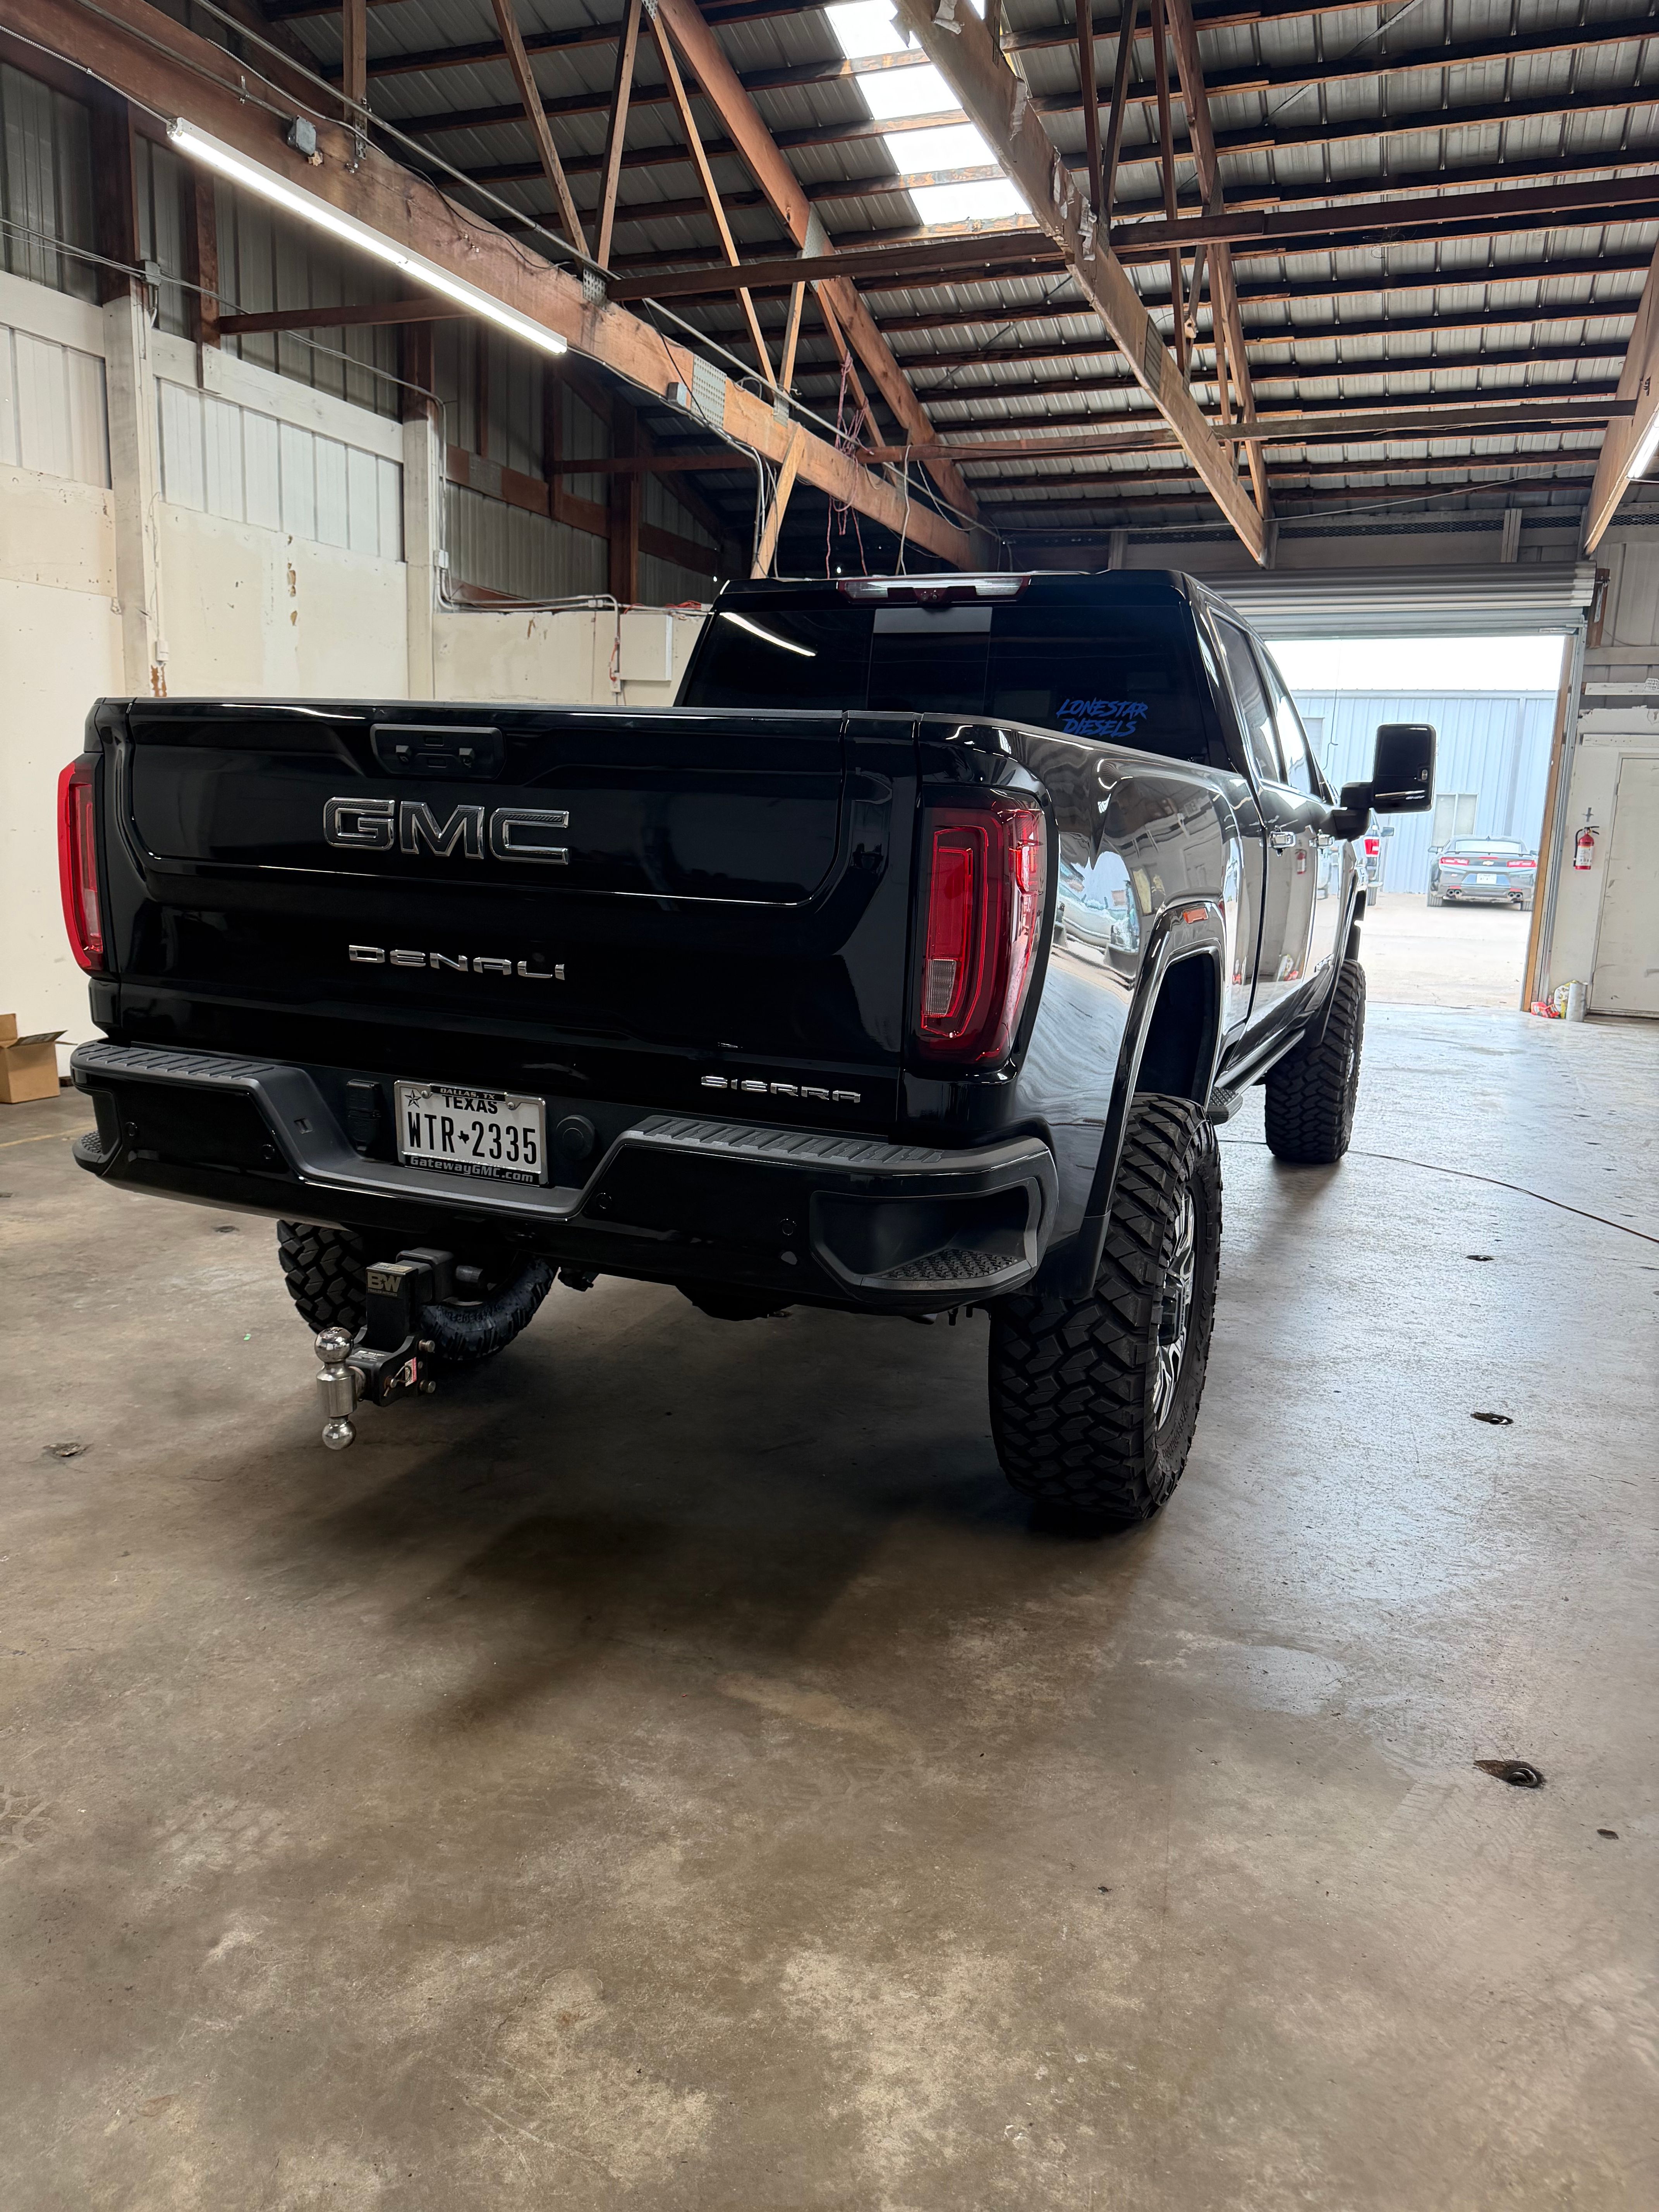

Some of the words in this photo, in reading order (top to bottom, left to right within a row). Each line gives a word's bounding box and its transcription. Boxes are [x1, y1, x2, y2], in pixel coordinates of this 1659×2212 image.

[1056, 697, 1148, 720] LONESTAR
[1062, 718, 1137, 738] DIESELS
[323, 797, 570, 865] GMC
[349, 945, 565, 980] DENALI
[701, 1075, 860, 1103] SIERRA
[442, 1095, 498, 1115] TEXAS
[410, 1156, 533, 1183] GatewayGMC.com
